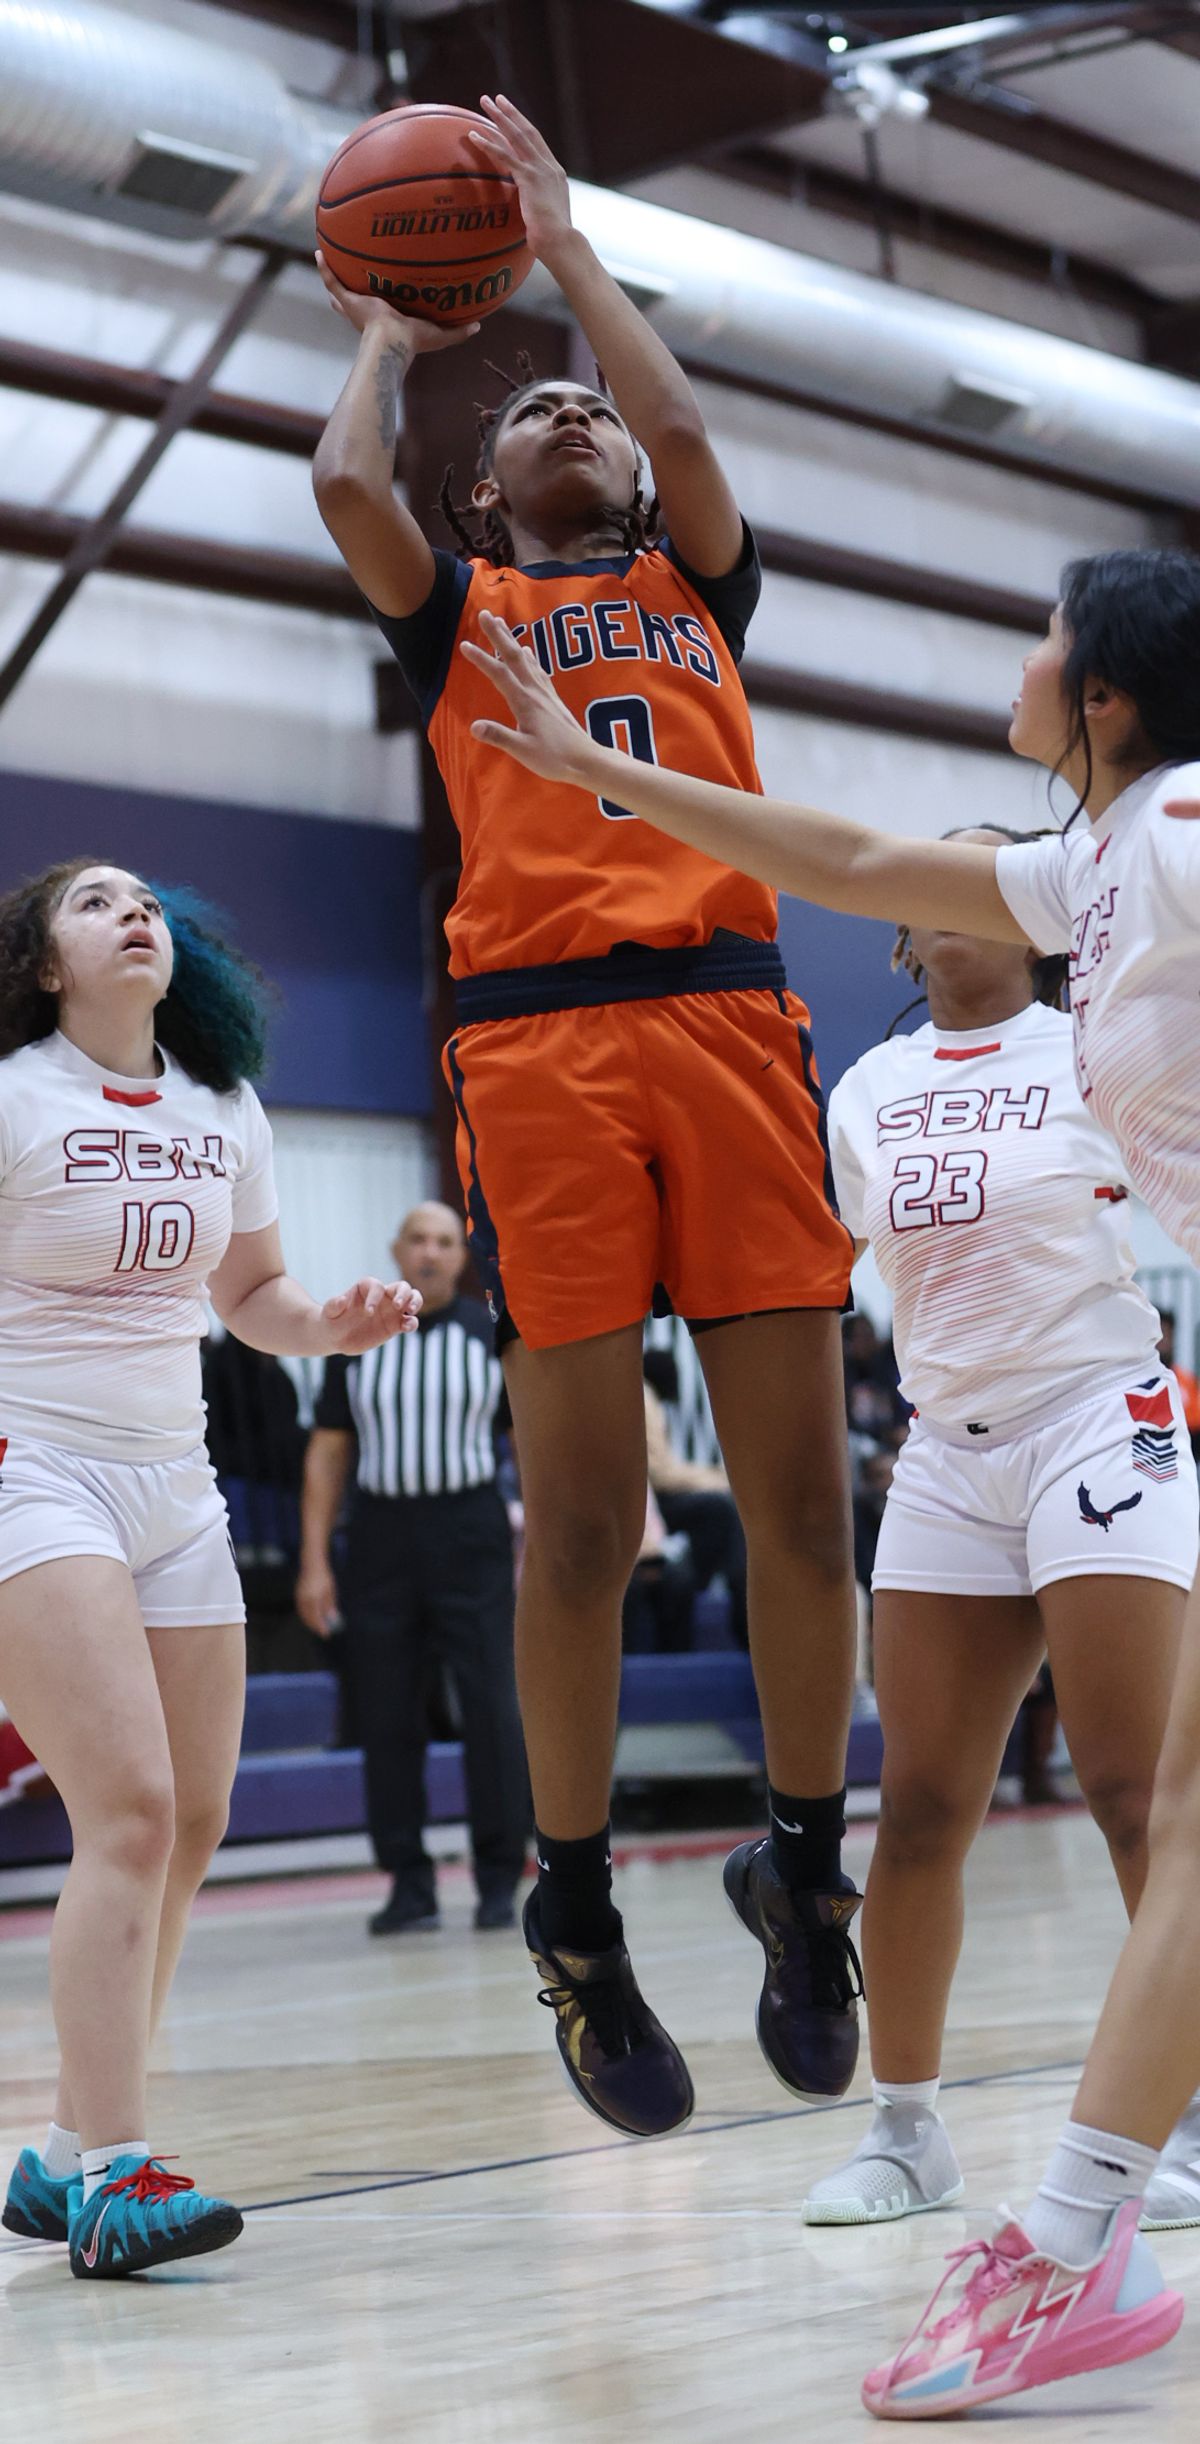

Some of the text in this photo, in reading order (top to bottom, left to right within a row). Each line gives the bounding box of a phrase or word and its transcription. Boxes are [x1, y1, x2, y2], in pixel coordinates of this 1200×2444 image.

[370, 204, 511, 237] EVOLUTION
[366, 265, 513, 312] Wilson
[494, 600, 722, 688] IGERS
[876, 1086, 1050, 1147] SBH
[63, 1128, 227, 1183] SBH
[889, 1149, 988, 1233] 23
[112, 1200, 195, 1273] 10
